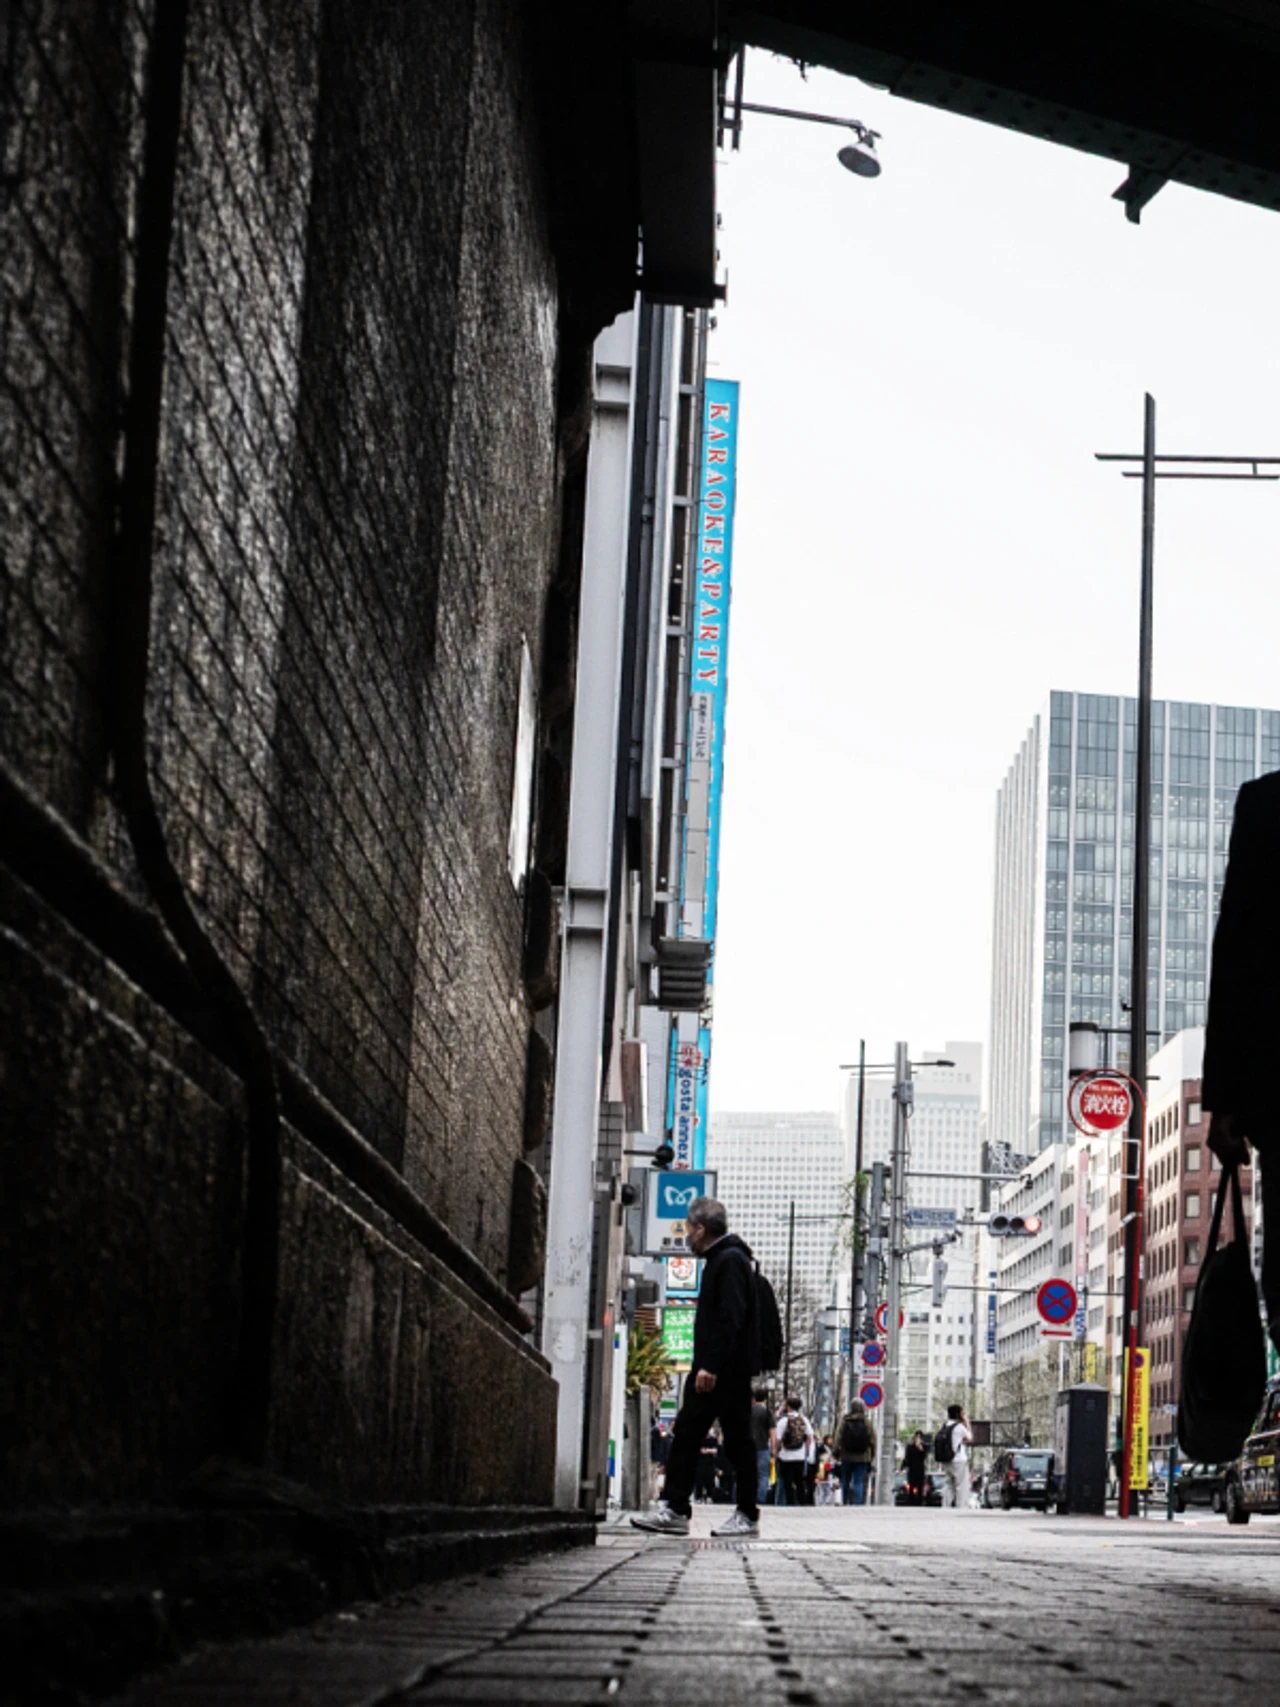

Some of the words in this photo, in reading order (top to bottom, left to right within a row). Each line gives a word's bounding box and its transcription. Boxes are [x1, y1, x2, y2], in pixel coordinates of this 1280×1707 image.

[698, 401, 730, 686] KARAOKE&PARTY
[1084, 1093, 1127, 1115] 消火栓
